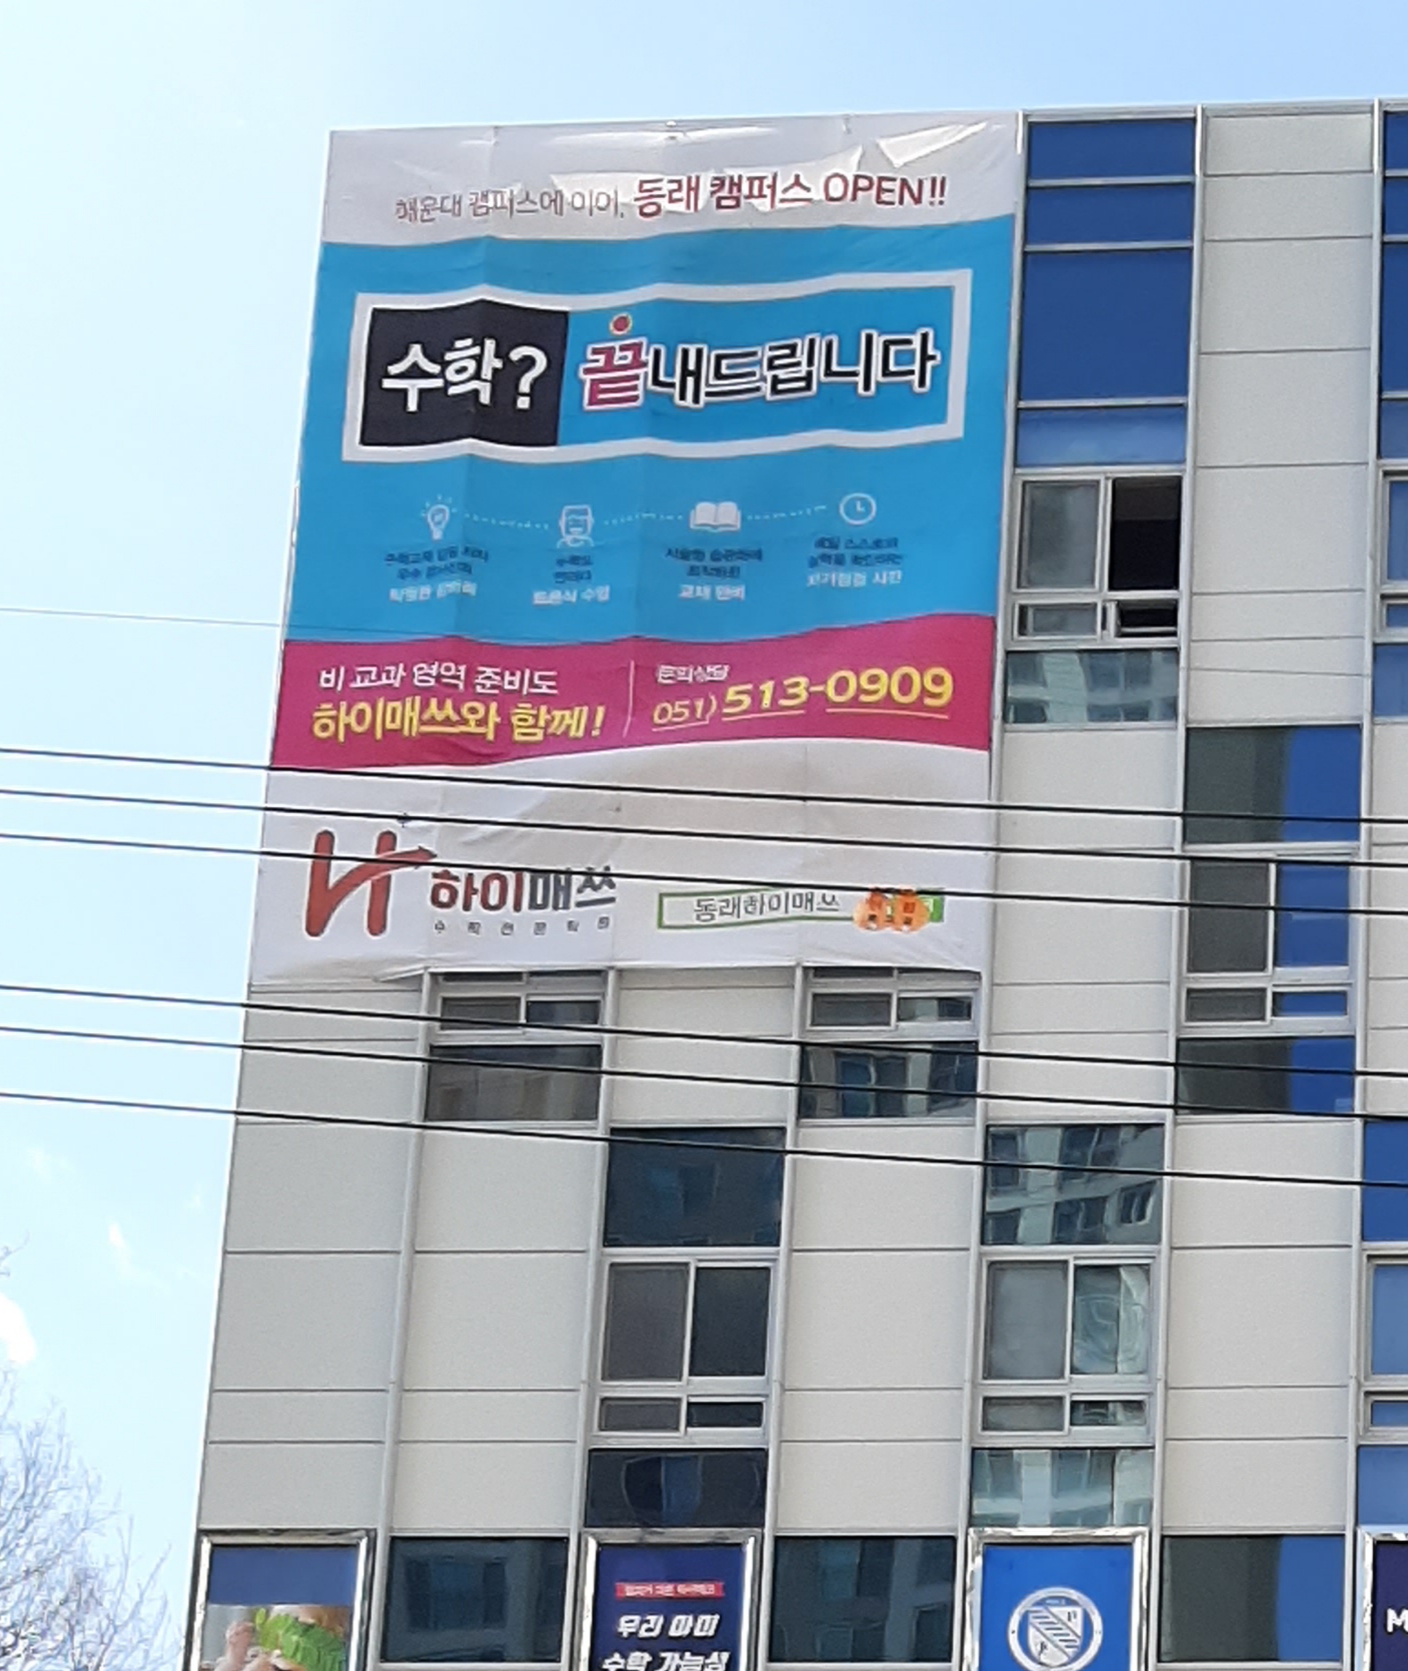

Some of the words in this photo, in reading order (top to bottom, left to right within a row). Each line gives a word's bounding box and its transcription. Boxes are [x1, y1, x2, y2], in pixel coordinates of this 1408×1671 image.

[633, 171, 701, 219] 동래
[709, 171, 814, 213] 캠퍼스
[822, 172, 948, 208] OPEN!!
[381, 338, 549, 413] 수학?
[580, 327, 942, 412] 끝내드립니다
[318, 665, 345, 693] 비
[349, 661, 406, 689] 교과
[411, 660, 466, 692] 영역
[474, 665, 560, 696] 준비도
[652, 693, 717, 725] 051)
[721, 665, 954, 714] 513-0909
[312, 695, 502, 743] 하이매쓰와
[510, 702, 607, 743] 함께!
[430, 865, 617, 913] 하이매쓰
[694, 891, 841, 924] 동래하이매쓰
[616, 1613, 664, 1638] 우리
